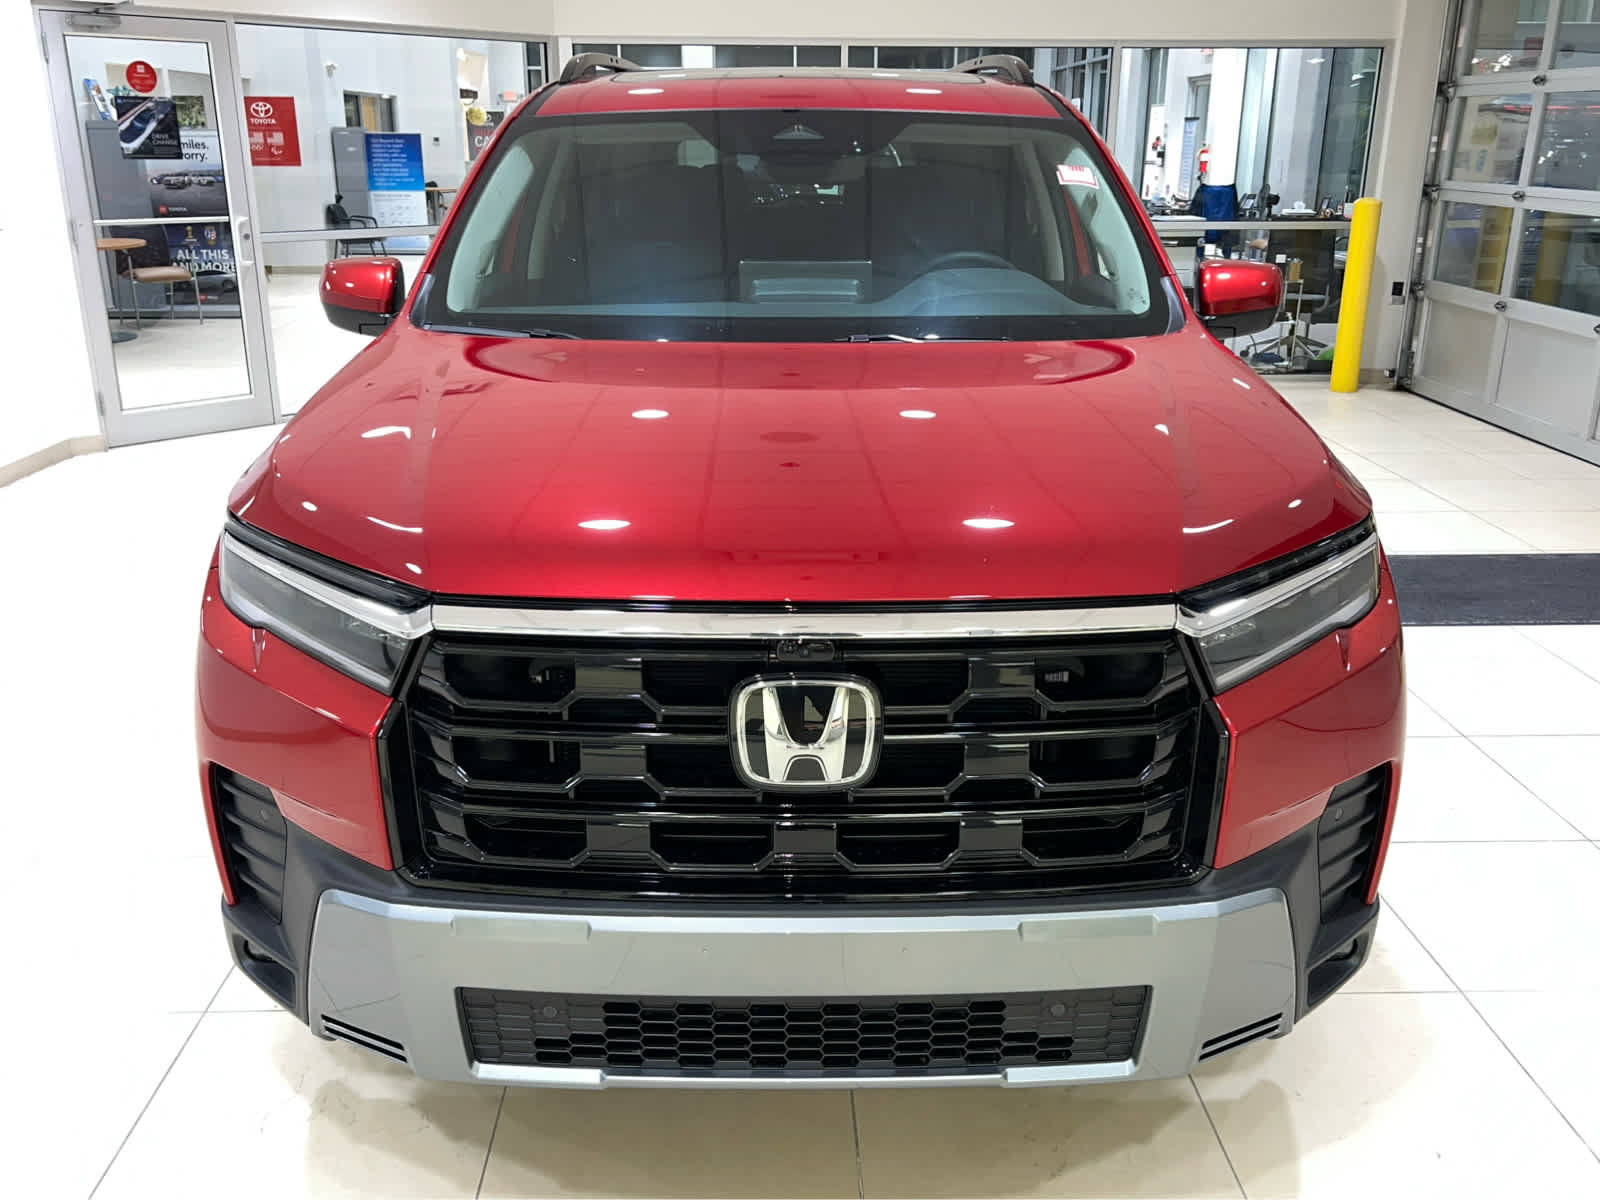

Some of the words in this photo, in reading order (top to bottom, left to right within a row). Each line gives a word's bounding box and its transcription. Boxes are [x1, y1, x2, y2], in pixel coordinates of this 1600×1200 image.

[181, 139, 208, 149] miles.
[182, 152, 208, 162] orry.
[177, 249, 199, 260] ALL
[200, 249, 229, 260] THIS
[200, 262, 236, 272] MORE
